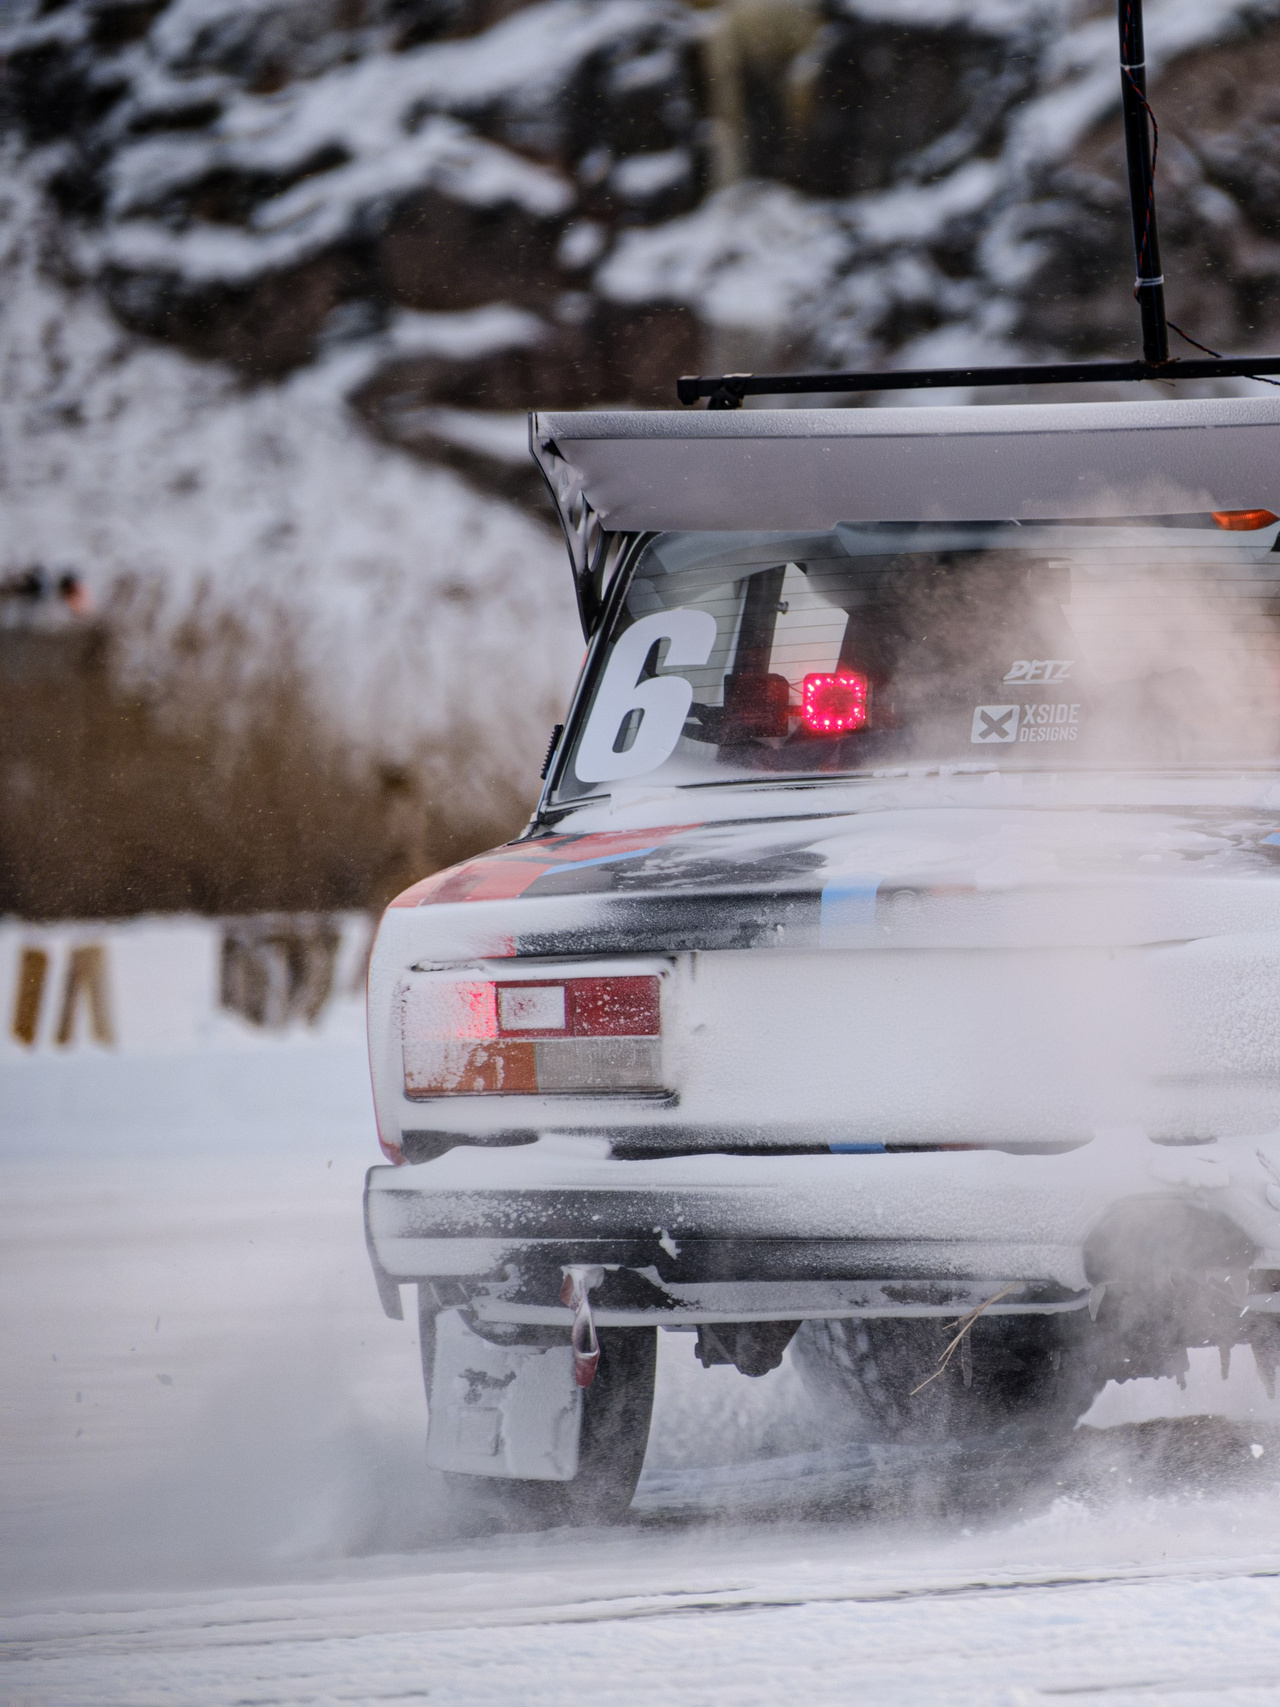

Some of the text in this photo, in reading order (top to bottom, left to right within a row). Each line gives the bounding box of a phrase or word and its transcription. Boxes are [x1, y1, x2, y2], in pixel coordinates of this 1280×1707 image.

[575, 609, 717, 784] 6
[1022, 703, 1081, 725] XSIDE
[1019, 726, 1078, 742] DESIGNS
